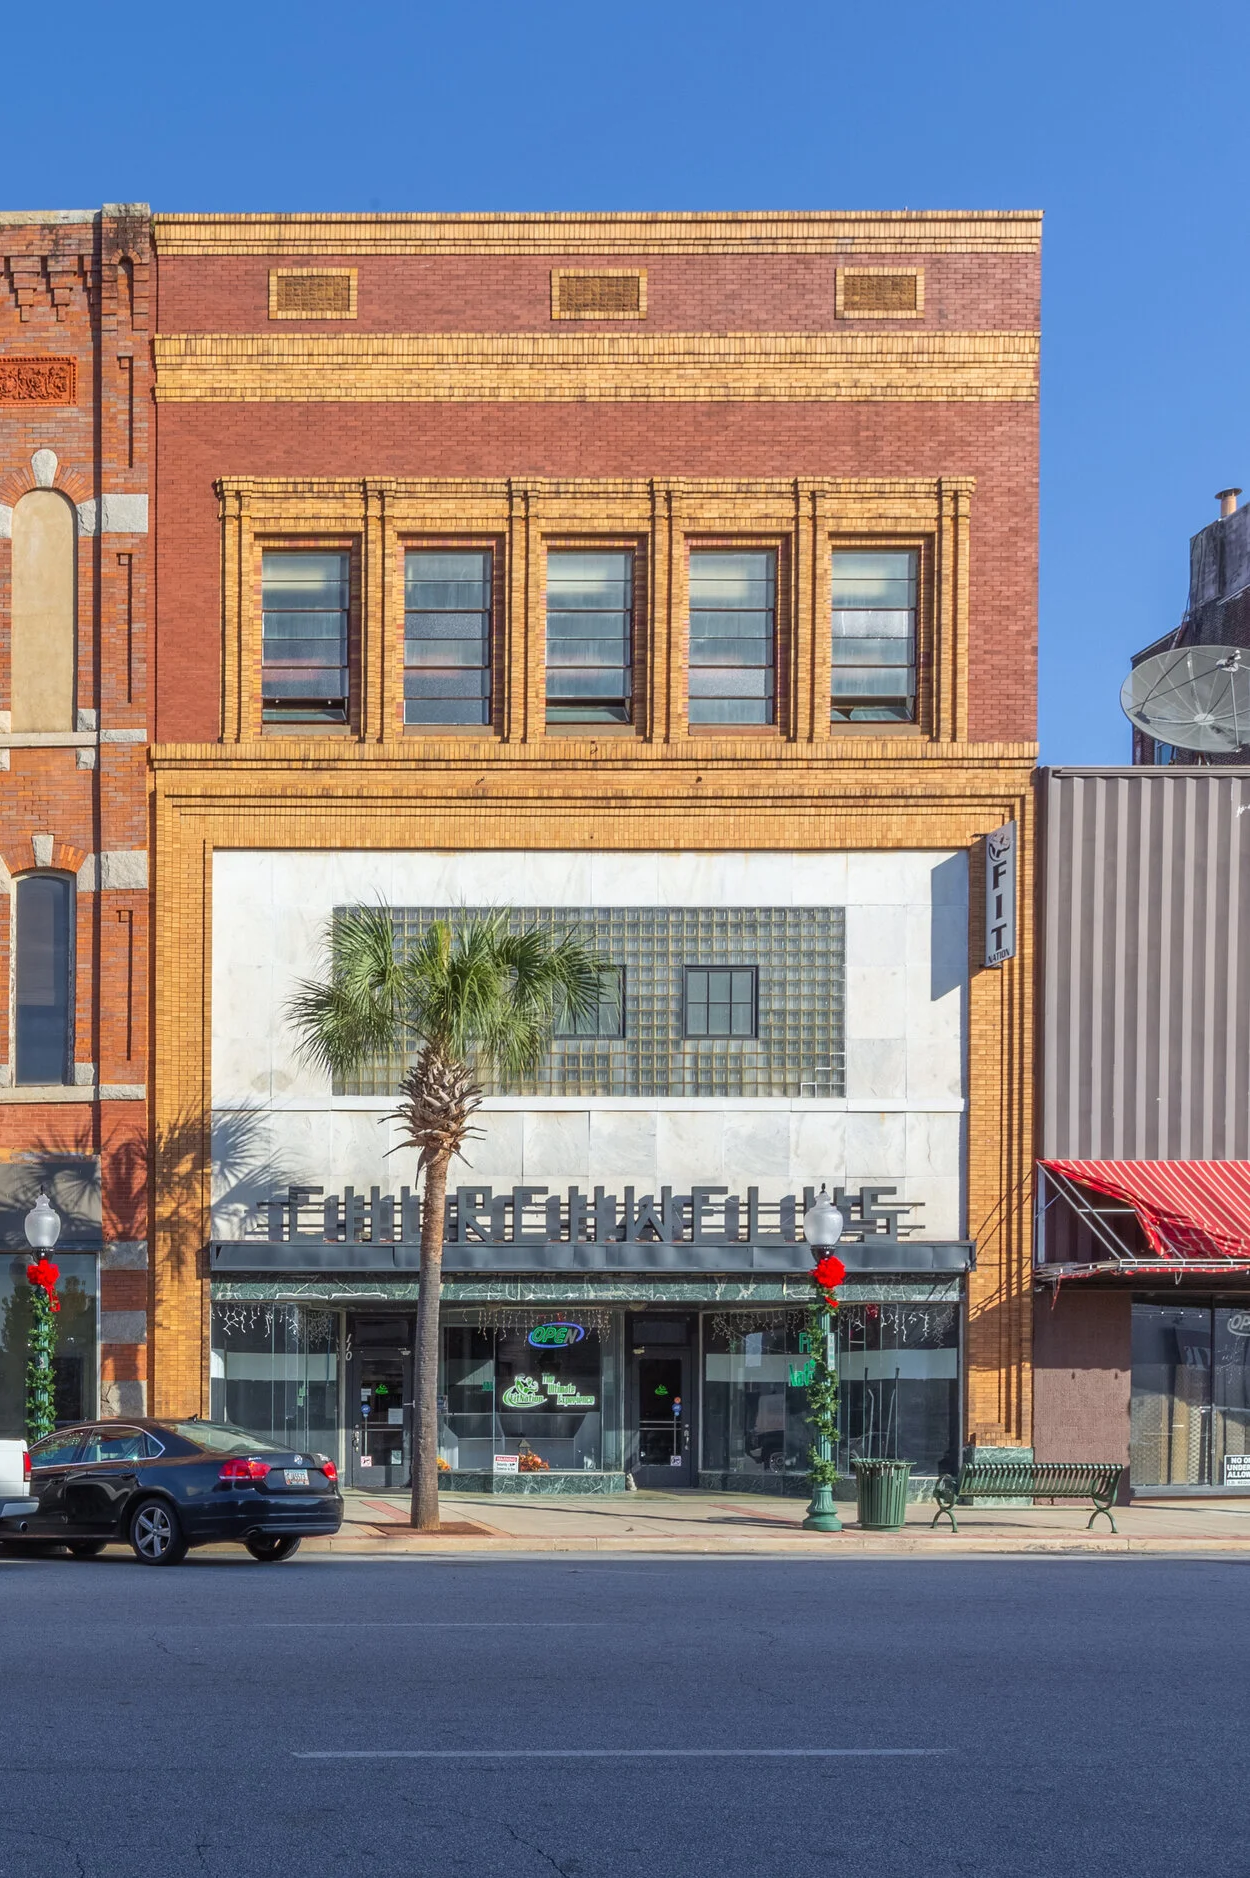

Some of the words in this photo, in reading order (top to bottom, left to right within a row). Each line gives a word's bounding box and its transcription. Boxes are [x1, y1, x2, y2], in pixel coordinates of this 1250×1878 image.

[991, 860, 1007, 951] FIT
[988, 949, 1010, 963] NATION
[531, 1326, 578, 1344] OPEN
